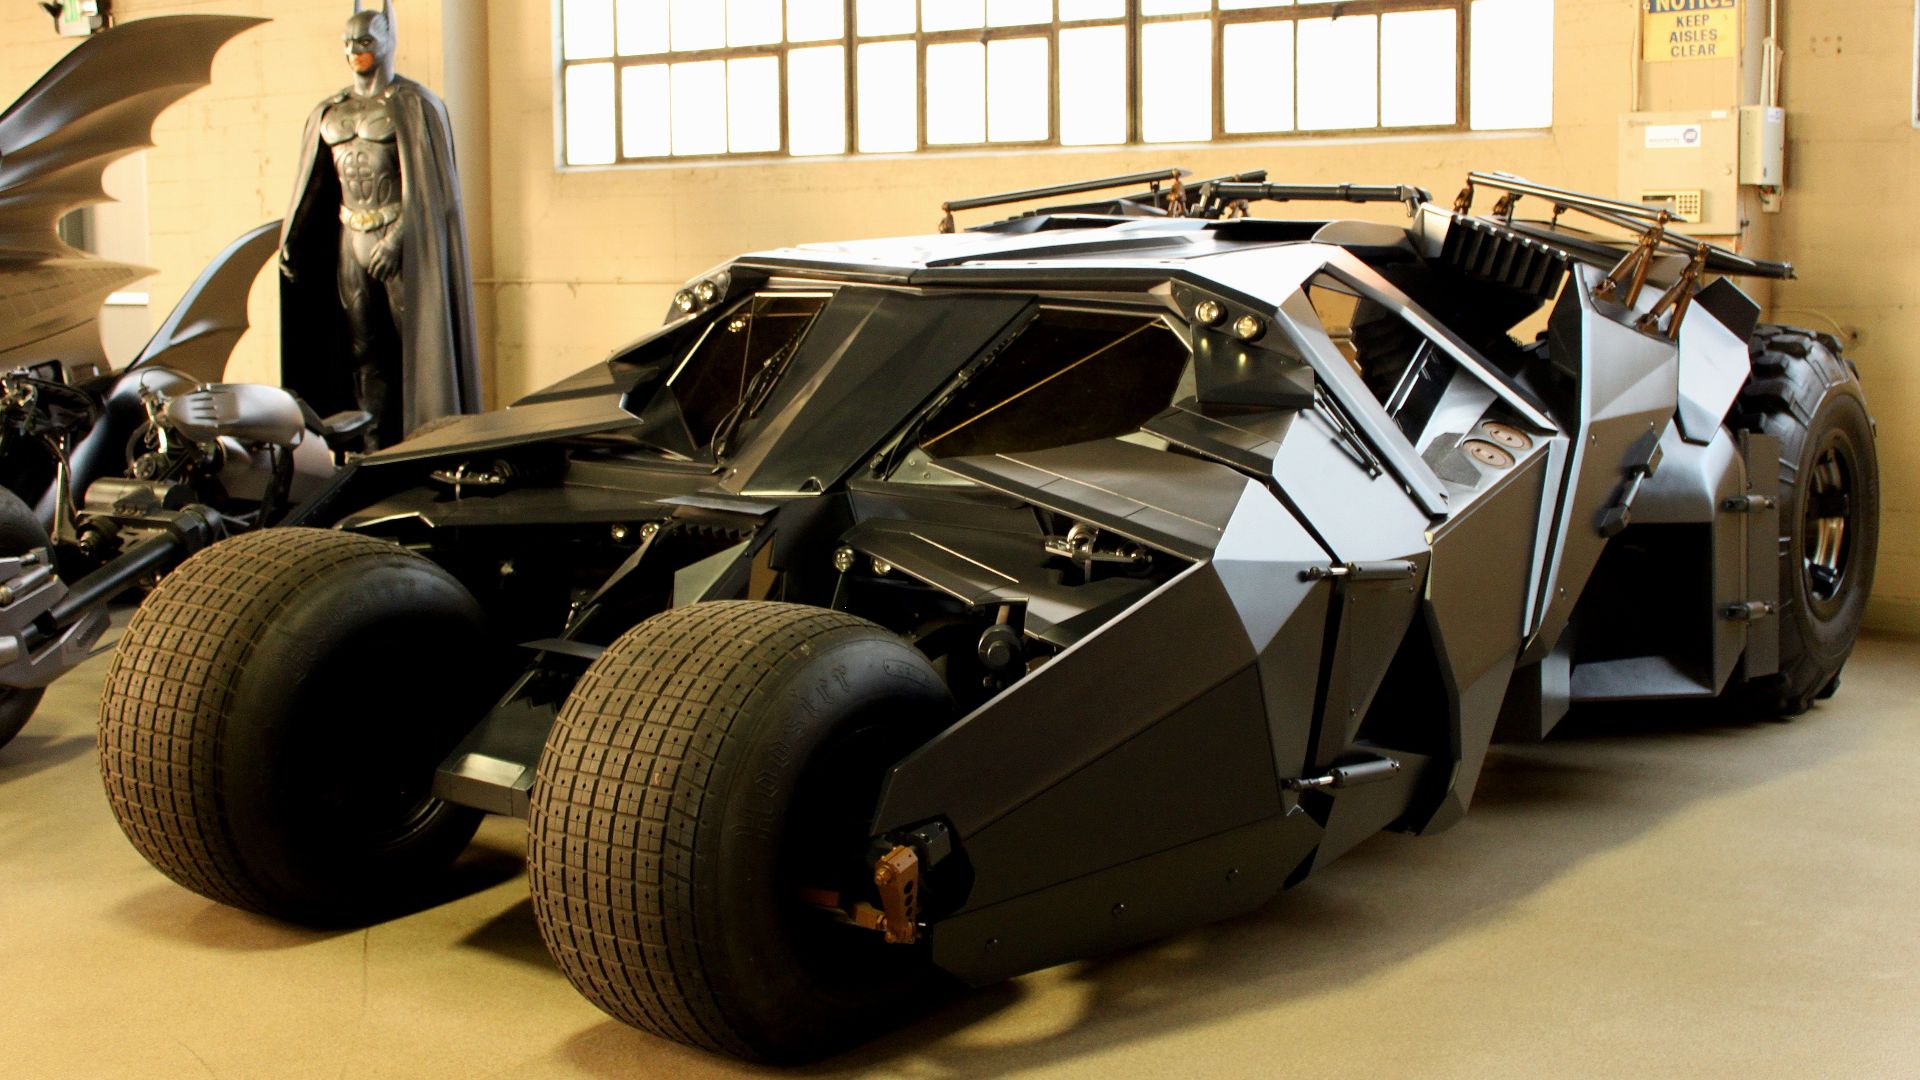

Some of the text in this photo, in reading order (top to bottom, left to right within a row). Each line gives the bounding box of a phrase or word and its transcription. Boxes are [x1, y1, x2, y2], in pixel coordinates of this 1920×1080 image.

[1676, 14, 1710, 28] KEEP
[1669, 28, 1718, 43] AISLES
[1670, 43, 1716, 57] CLEAR
